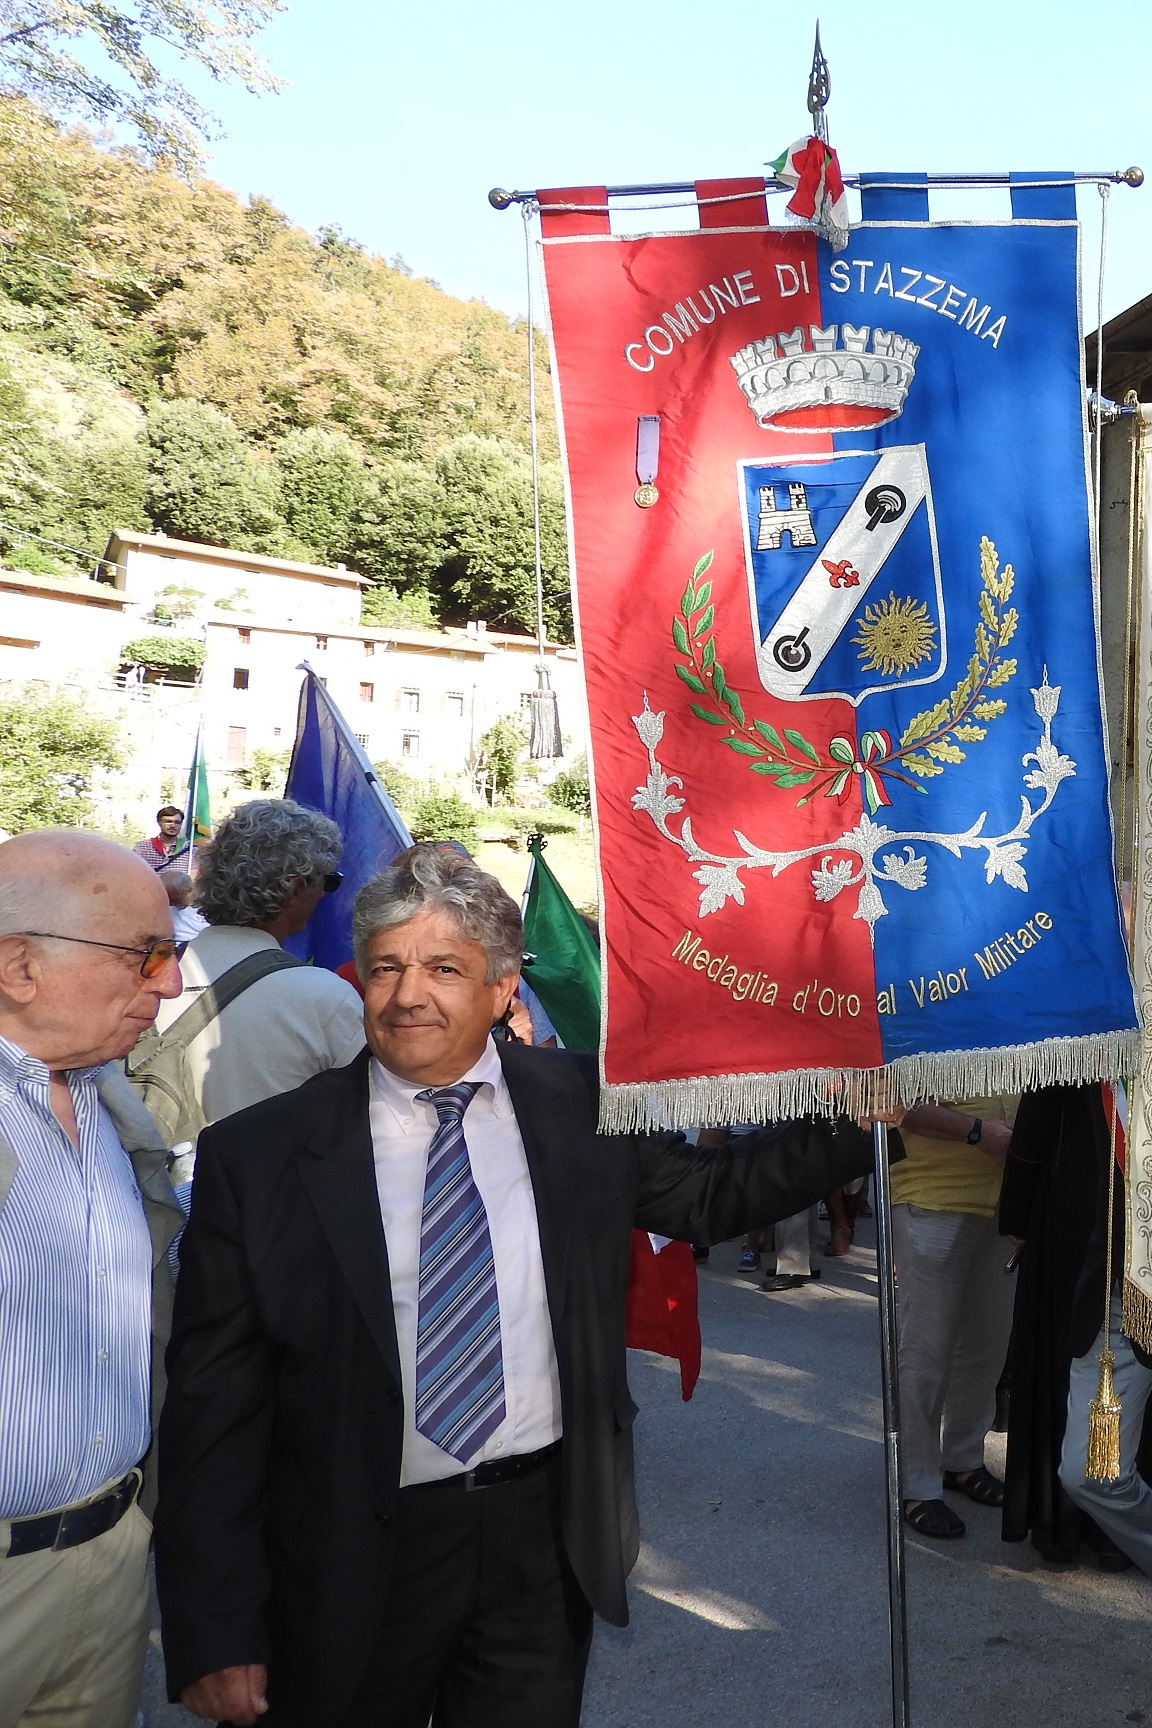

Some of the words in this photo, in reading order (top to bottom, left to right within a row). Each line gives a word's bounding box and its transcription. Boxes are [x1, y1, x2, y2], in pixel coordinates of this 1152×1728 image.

[625, 269, 761, 373] COMUNE
[775, 260, 810, 297] DI
[829, 259, 1009, 349] STAZZEMA
[671, 929, 778, 1007] Medaglia
[792, 979, 861, 1017] d'Oro
[876, 984, 897, 1015] al
[908, 966, 968, 1009] Valor
[974, 910, 1054, 981] Militare
